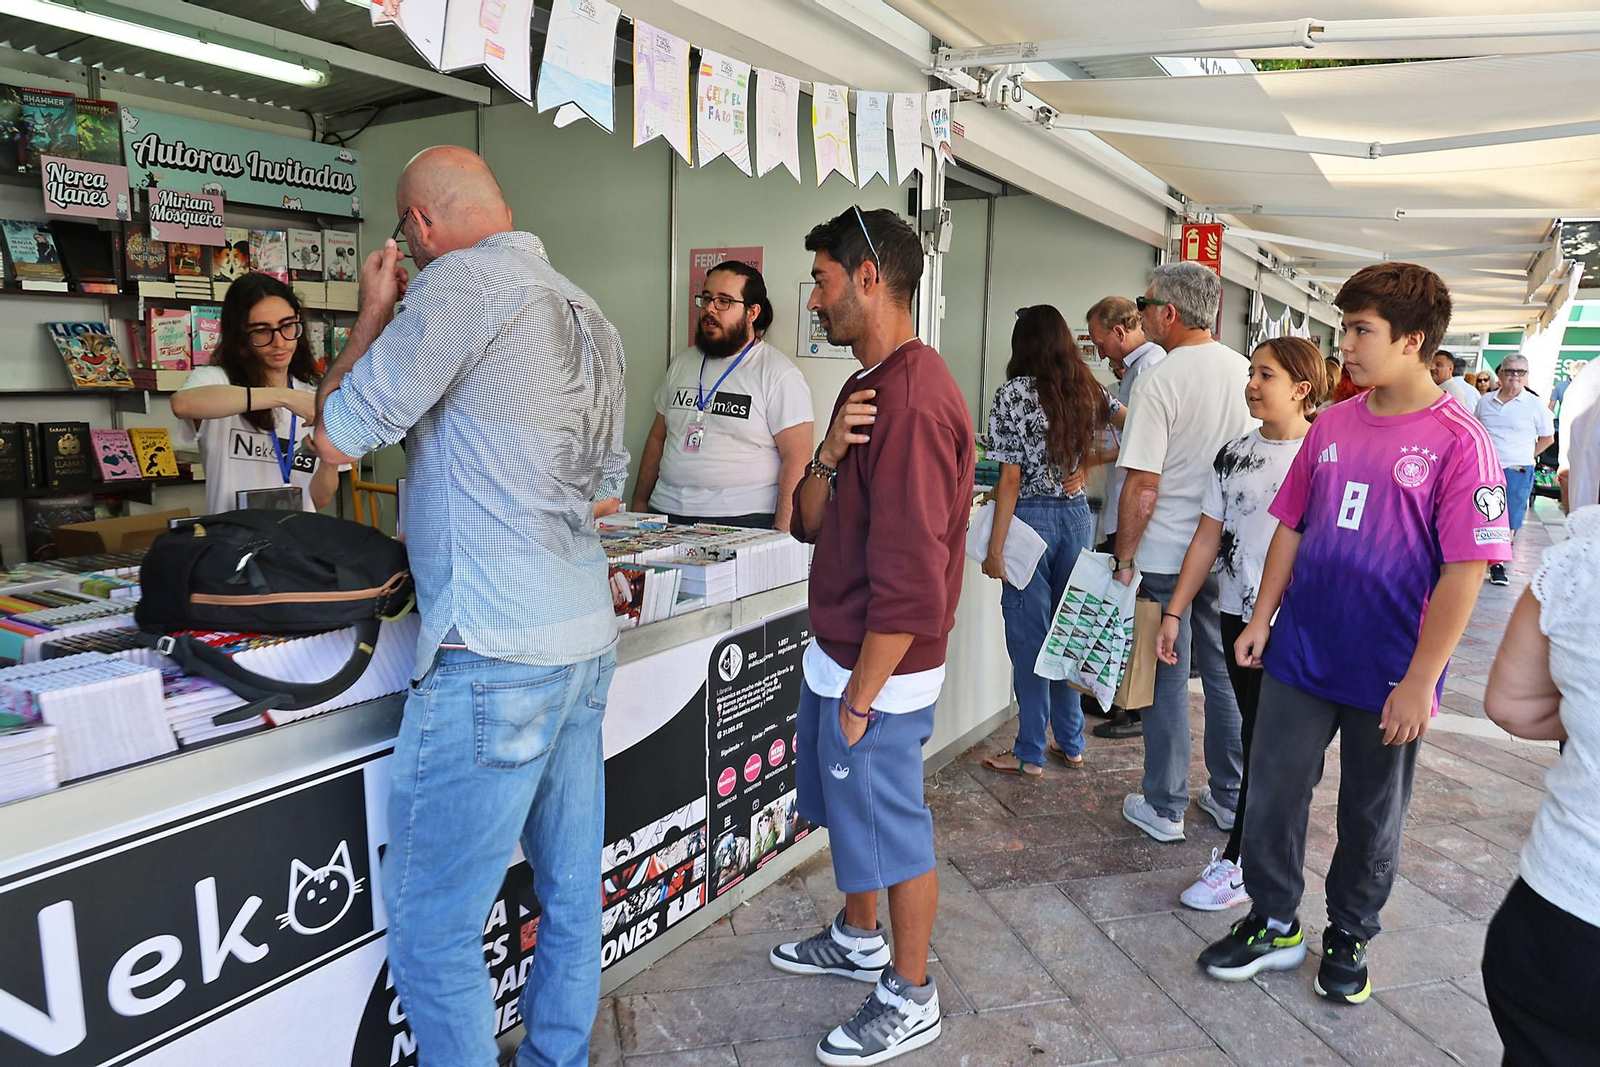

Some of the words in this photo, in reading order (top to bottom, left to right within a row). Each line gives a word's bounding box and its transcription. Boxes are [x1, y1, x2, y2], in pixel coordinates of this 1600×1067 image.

[23, 95, 64, 106] RHAMMER
[46, 162, 107, 189] Nerea
[132, 133, 243, 177] Autoras
[246, 151, 356, 194] Invitadas
[46, 181, 110, 208] Llanes
[158, 190, 214, 212] Miriam
[150, 204, 223, 228] Mosquera
[695, 253, 723, 267] FERIA
[1337, 481, 1369, 531] 8
[601, 911, 659, 967] ONES
